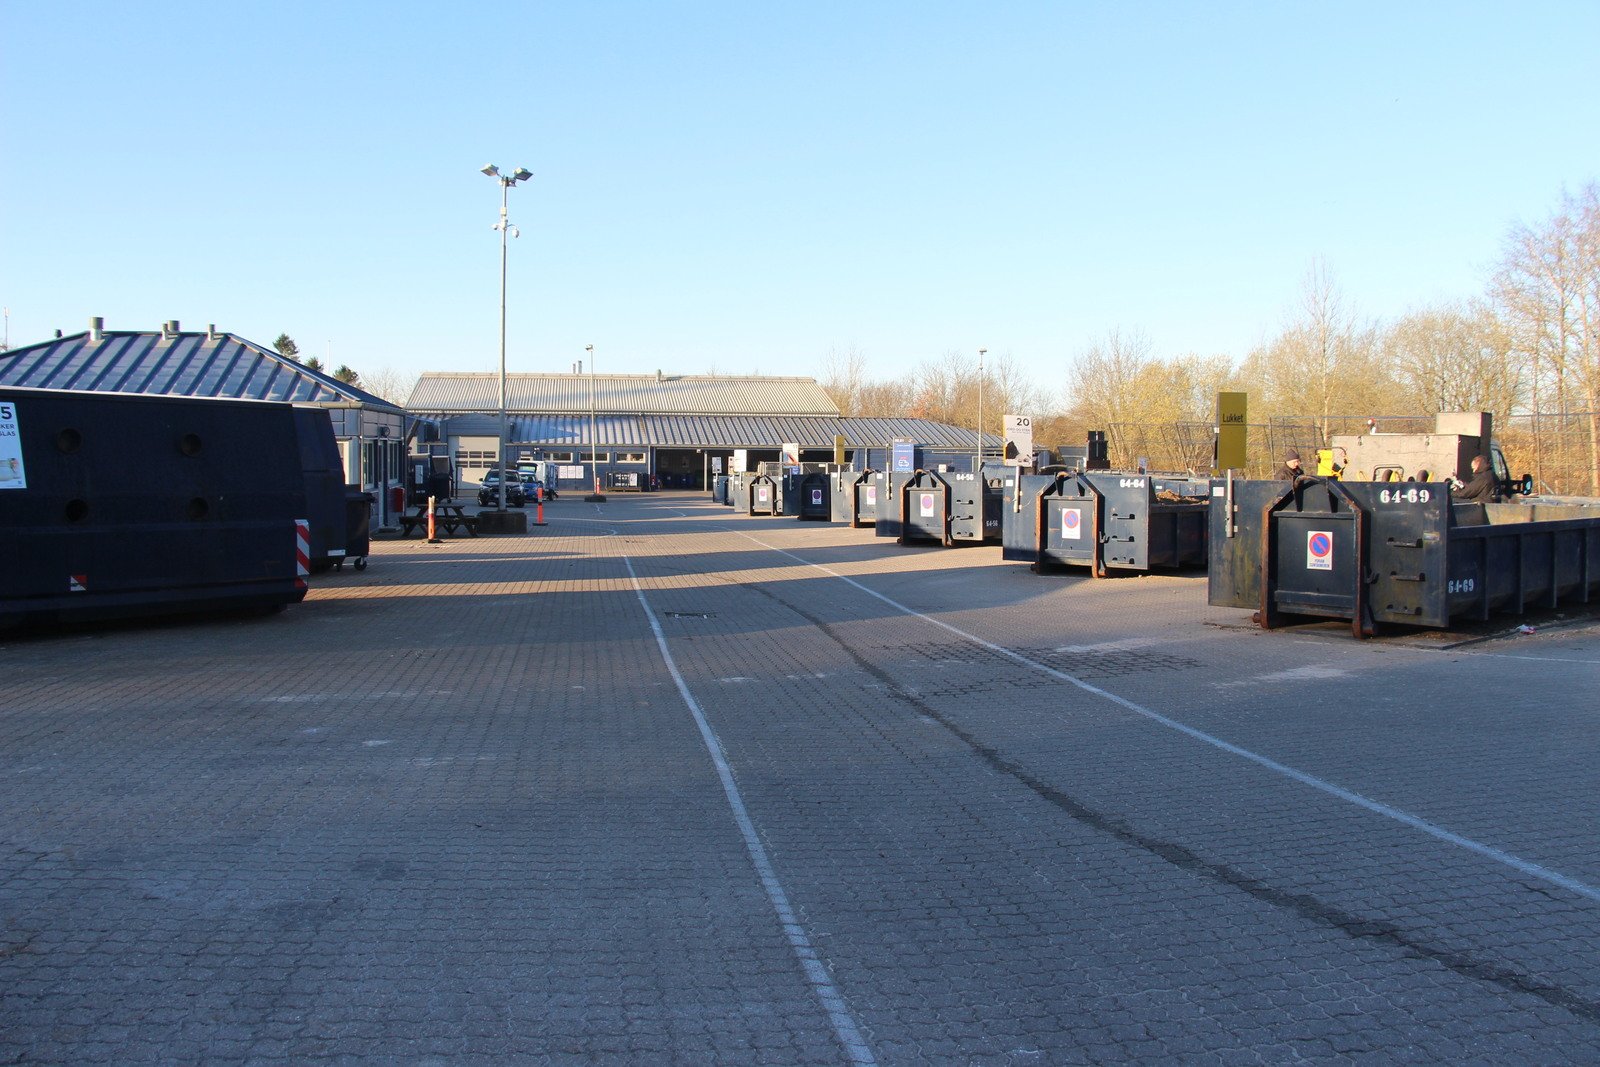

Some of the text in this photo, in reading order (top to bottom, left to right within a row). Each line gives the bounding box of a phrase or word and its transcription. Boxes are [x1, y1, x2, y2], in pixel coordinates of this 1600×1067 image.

[1016, 417, 1030, 427] 20
[1222, 413, 1244, 423] Lukket
[1120, 479, 1145, 488] 64-64
[1380, 489, 1430, 503] 64-69
[1448, 578, 1474, 594] 64-69
